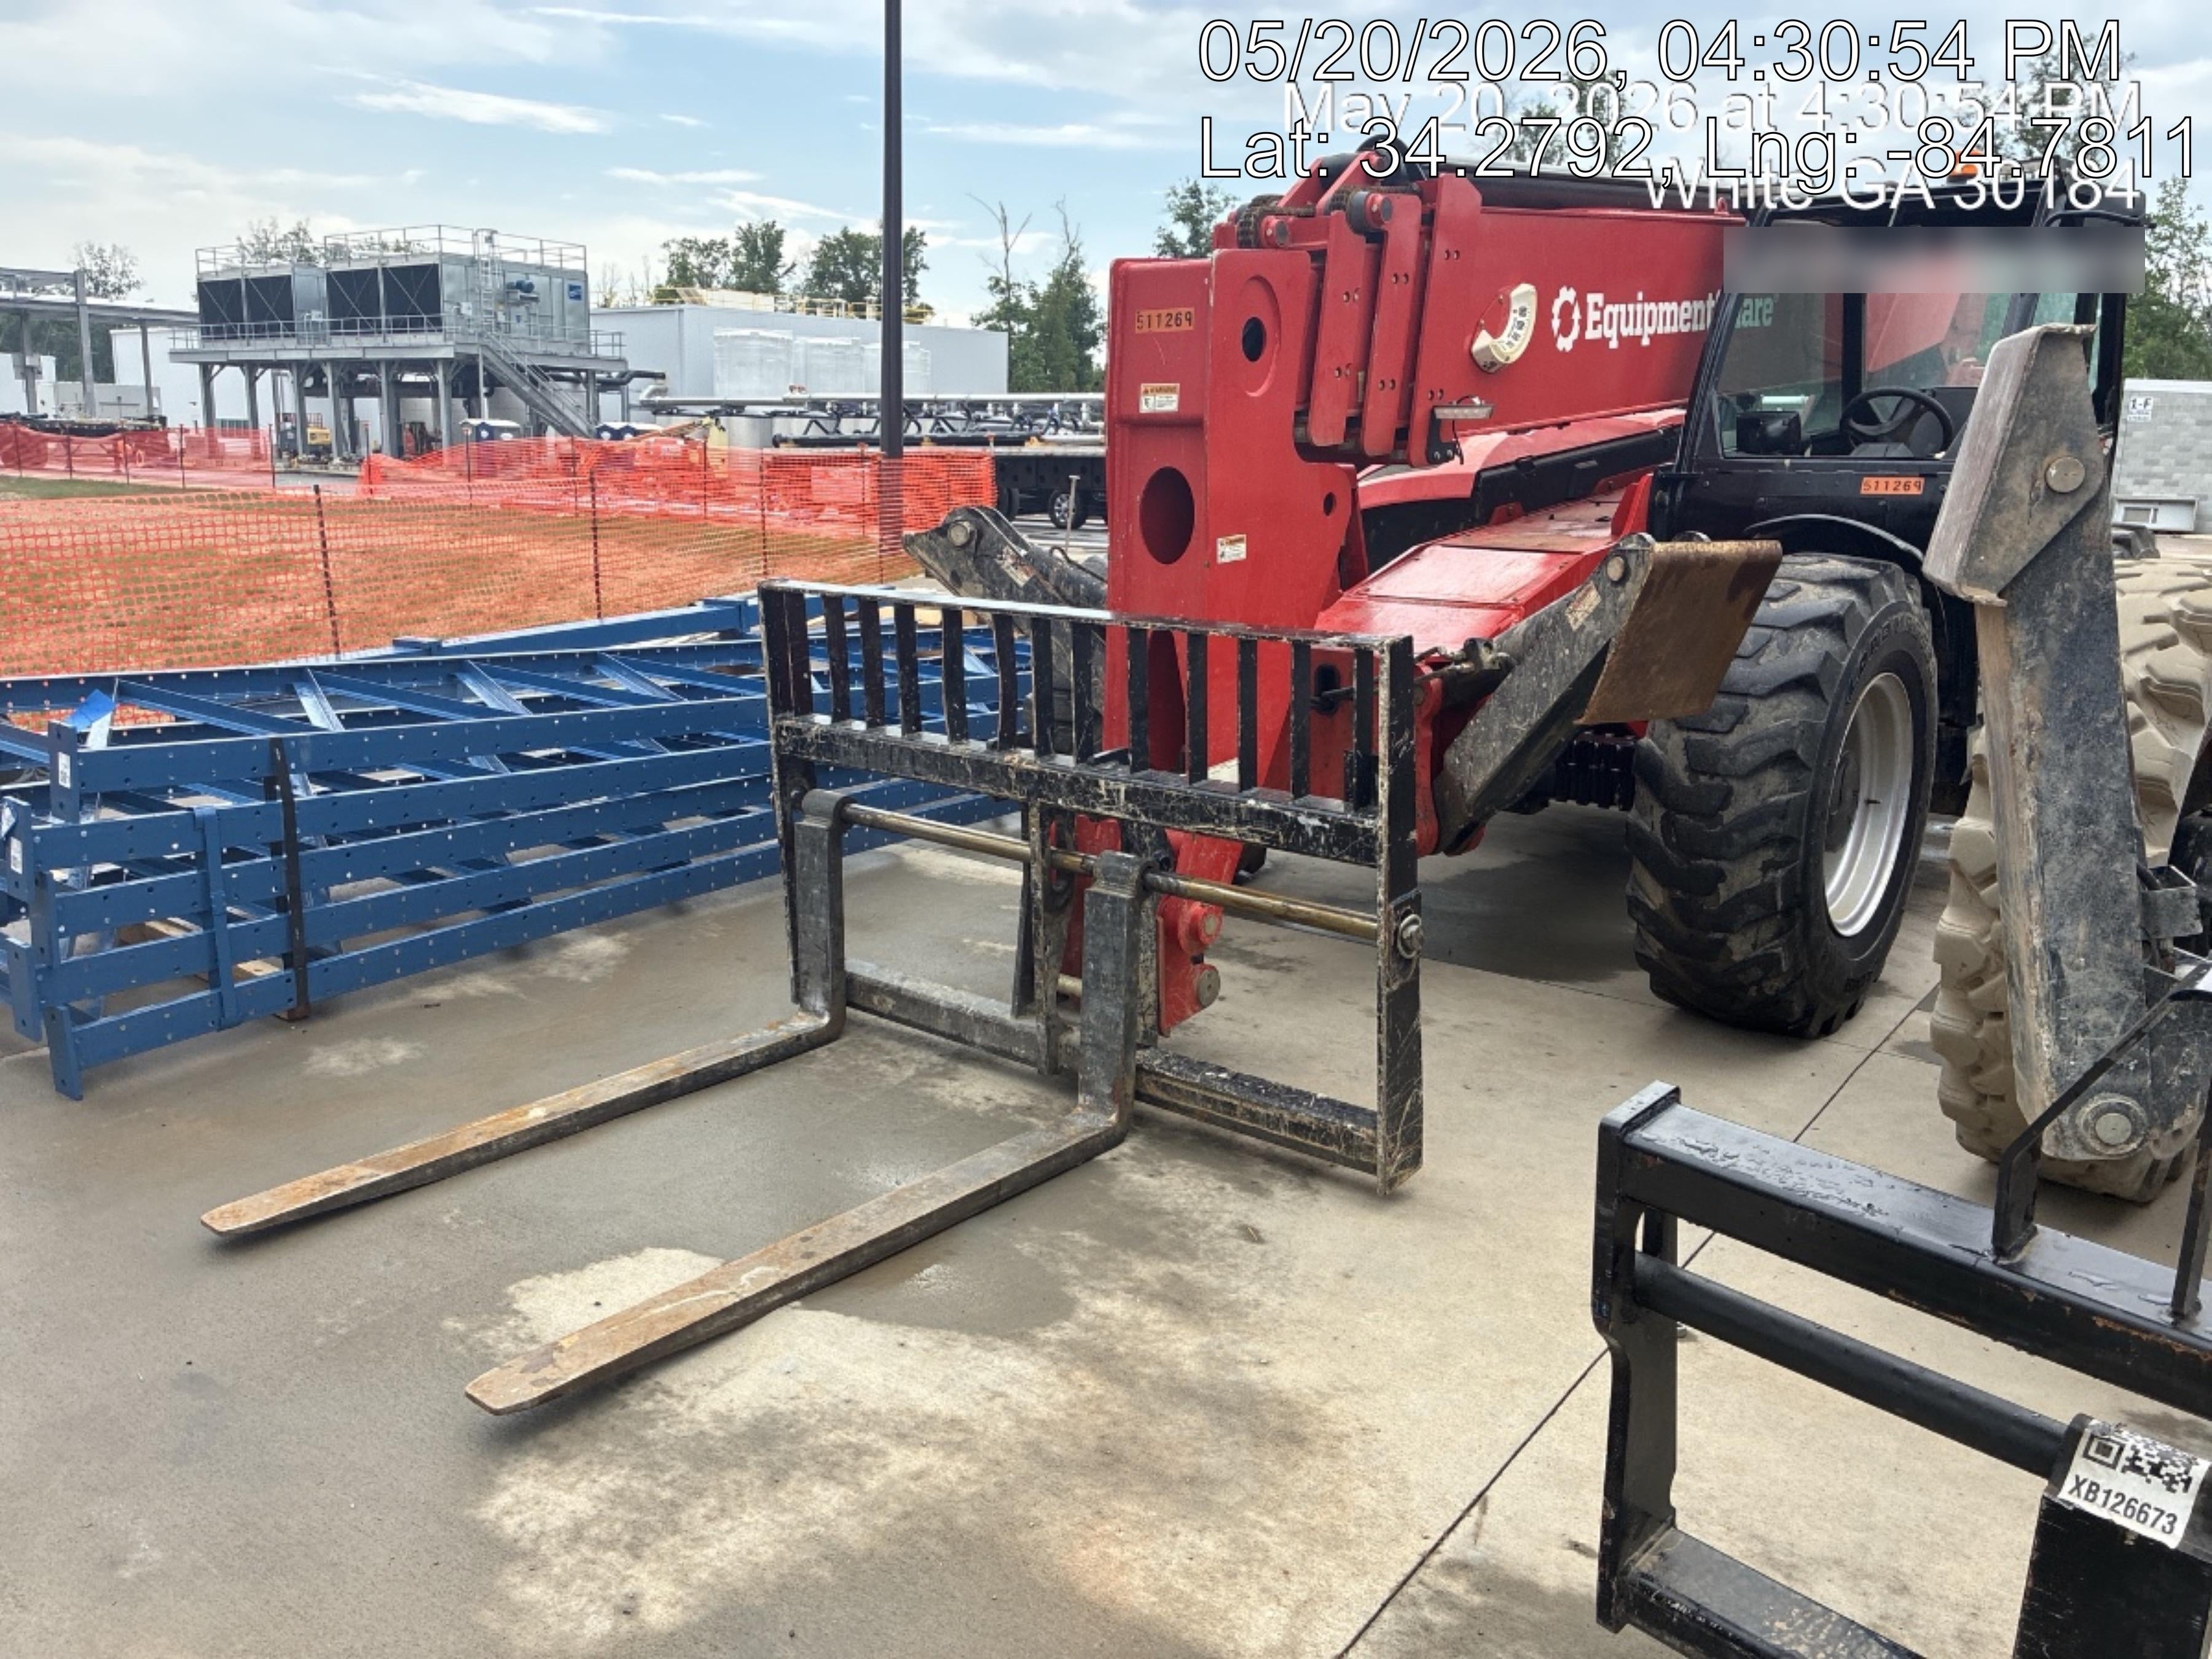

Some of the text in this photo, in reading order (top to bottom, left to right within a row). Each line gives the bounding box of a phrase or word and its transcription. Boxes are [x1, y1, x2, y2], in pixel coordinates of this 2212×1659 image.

[1137, 311, 1192, 329] 511269
[1863, 480, 1921, 492] 511269
[2068, 1475, 2177, 1534] XB126673
